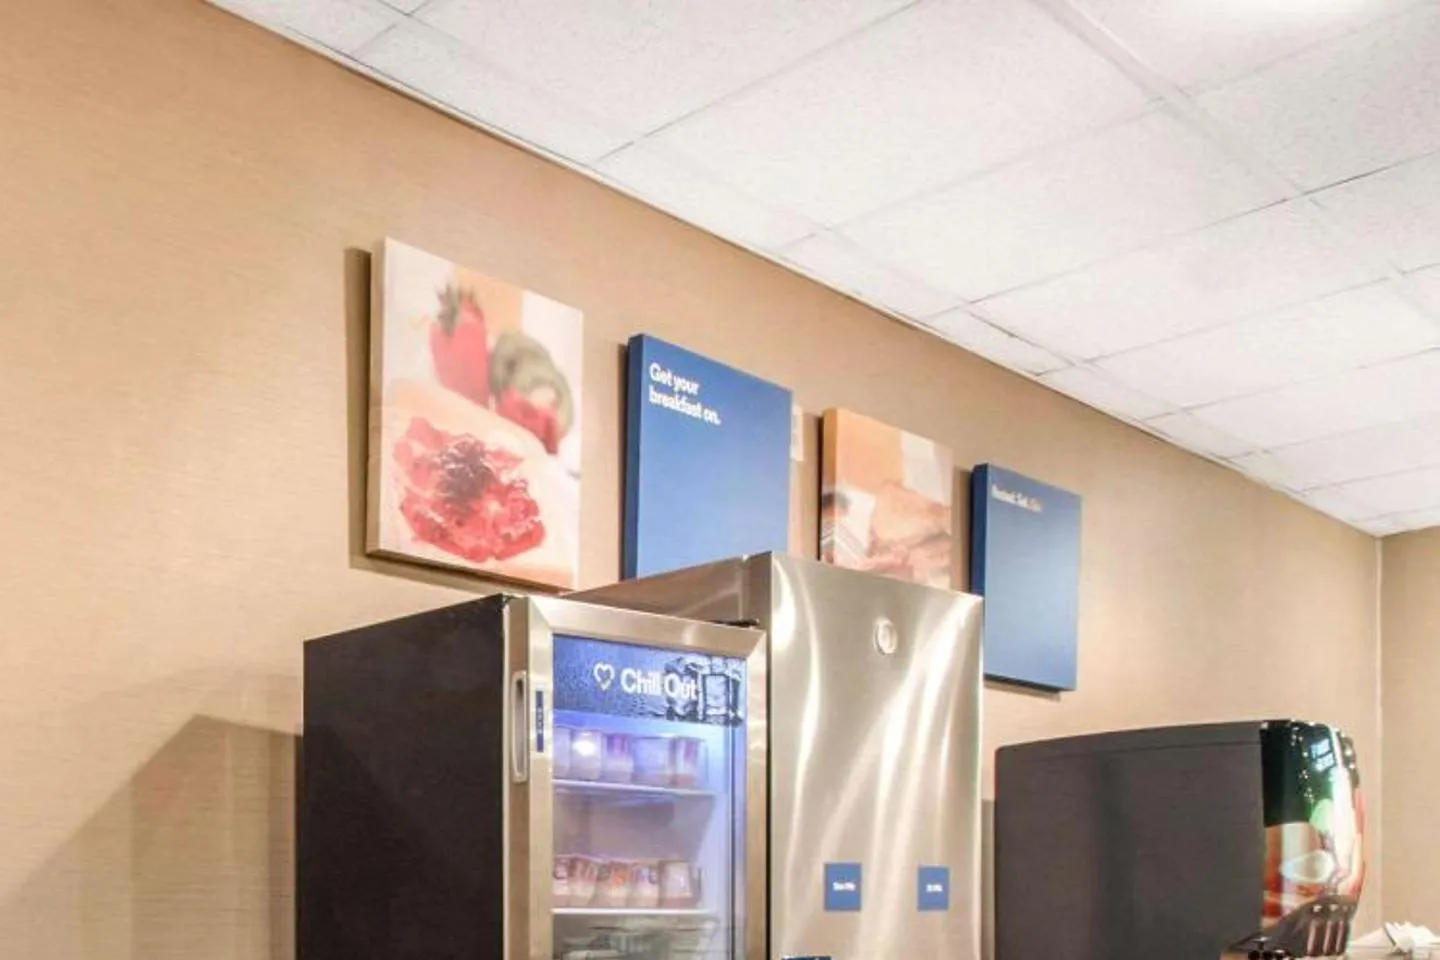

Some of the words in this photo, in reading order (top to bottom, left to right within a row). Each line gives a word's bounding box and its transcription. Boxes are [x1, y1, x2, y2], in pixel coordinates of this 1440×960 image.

[649, 362, 672, 386] Get
[673, 376, 699, 394] your
[649, 385, 702, 419] breakfast
[620, 668, 660, 696] Chill
[664, 674, 697, 699] Out
